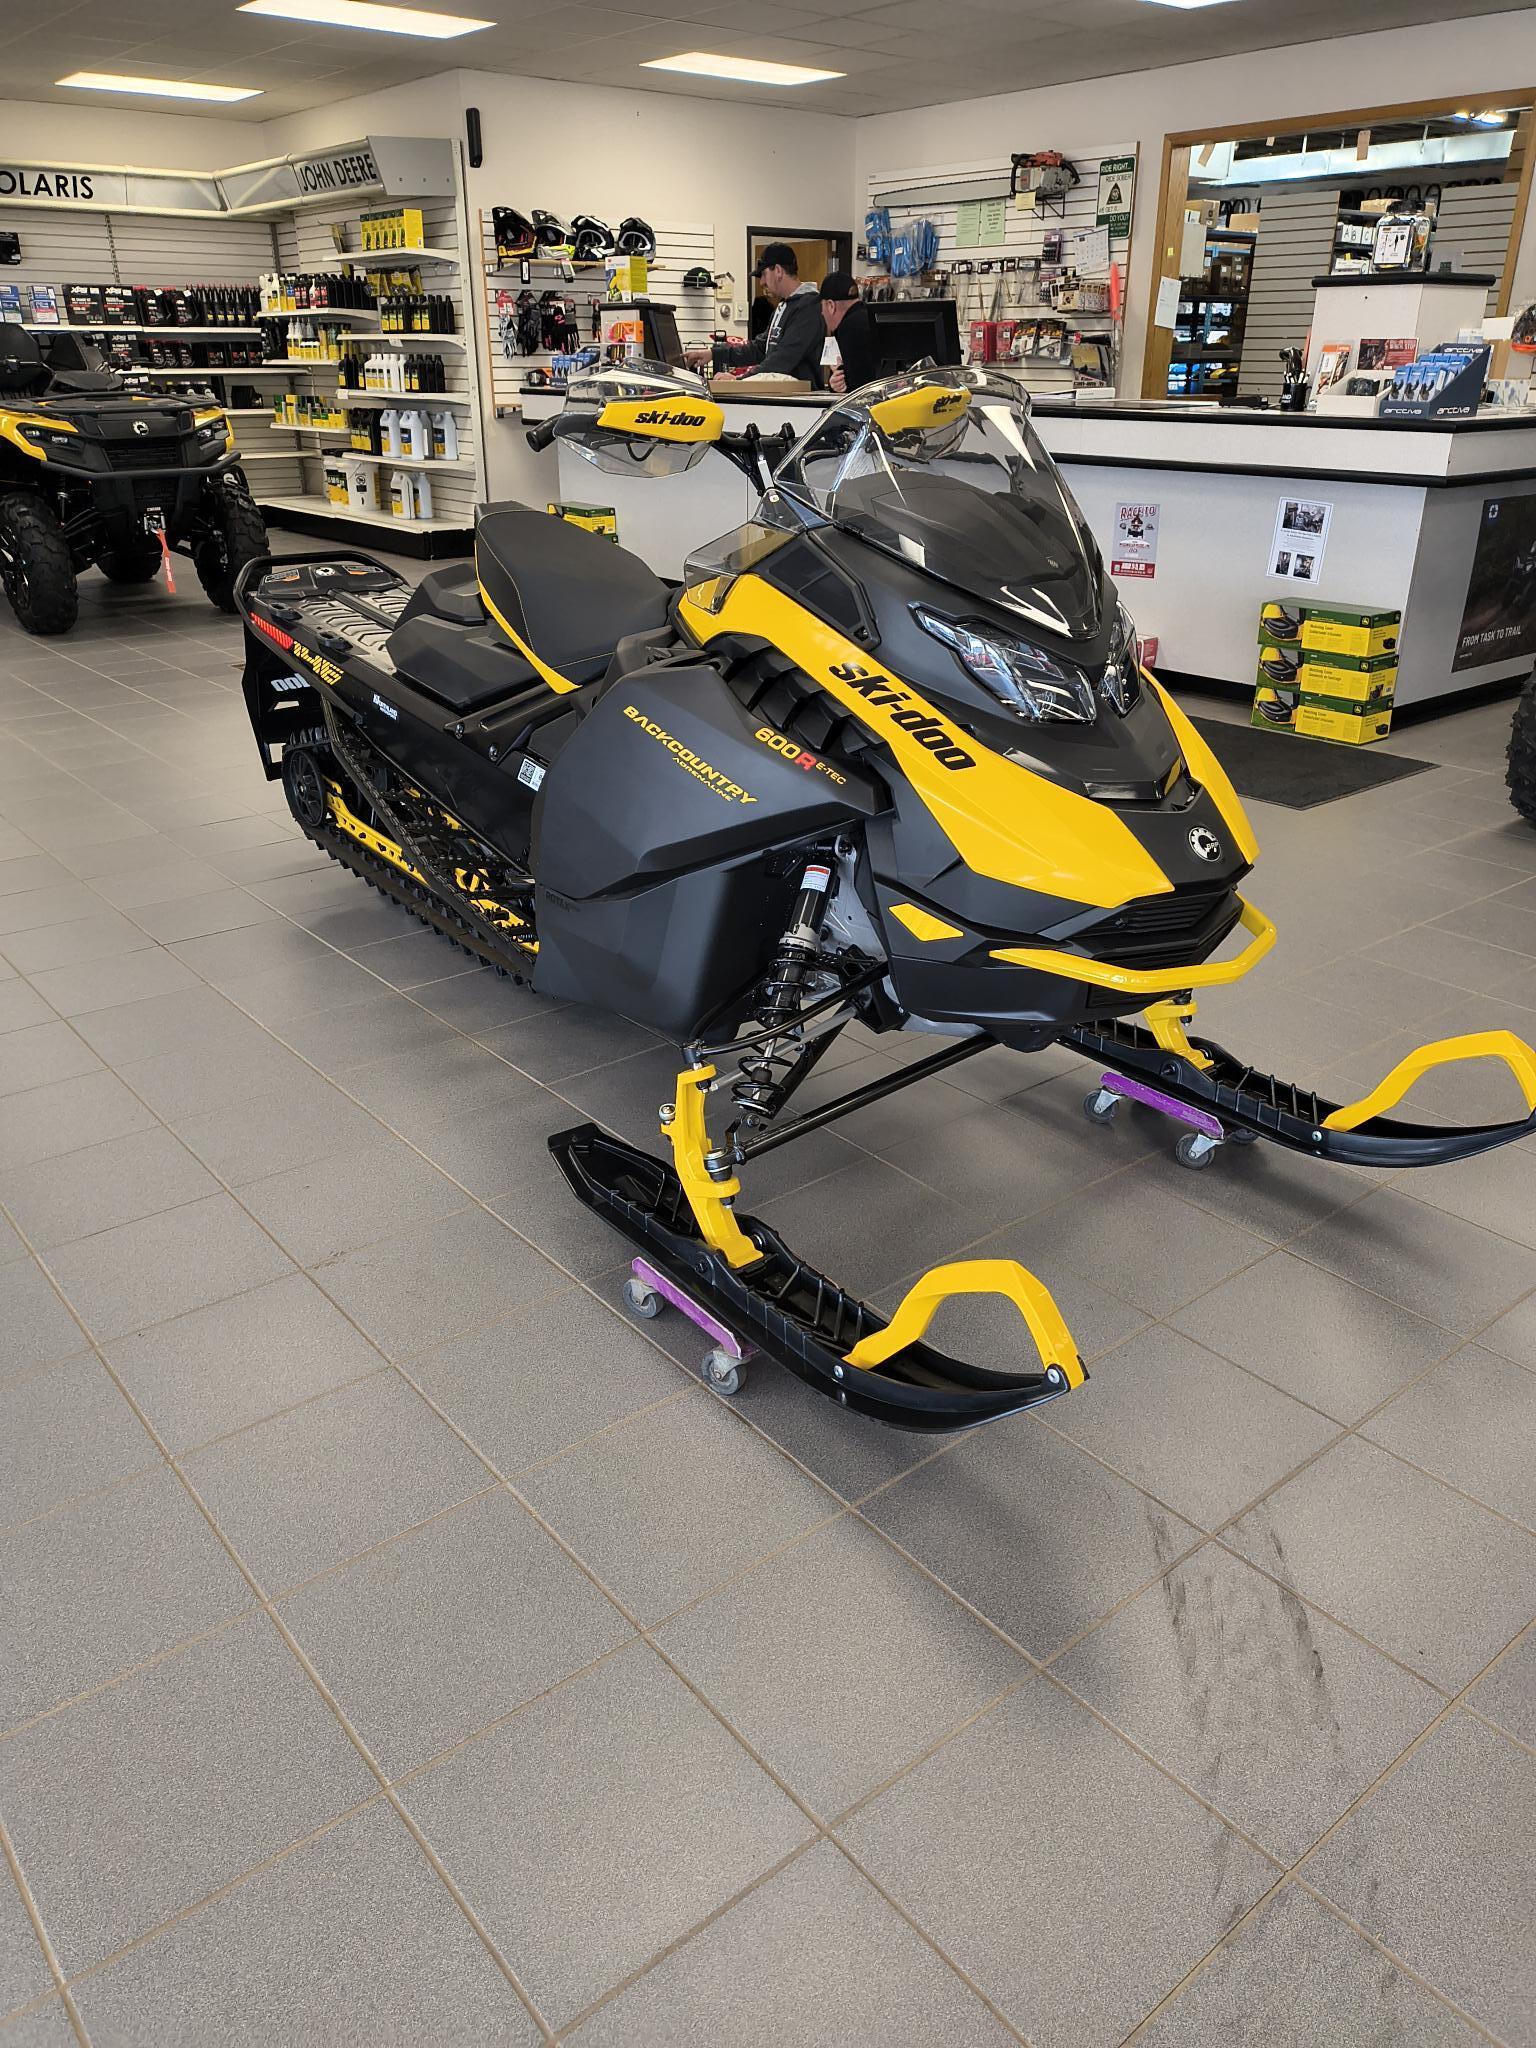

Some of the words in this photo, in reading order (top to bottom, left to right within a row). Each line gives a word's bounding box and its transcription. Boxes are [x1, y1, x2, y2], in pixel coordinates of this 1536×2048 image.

[300, 162, 336, 191] JOHN
[333, 154, 377, 185] DEERE
[1101, 165, 1112, 174] RIDE
[1105, 175, 1115, 183] RIDE
[1109, 214, 1117, 222] DO
[634, 410, 706, 426] ski-doo
[1436, 406, 1470, 415] arctiva
[1120, 505, 1143, 520] RACE
[1144, 505, 1157, 517] TO
[1461, 633, 1479, 648] FROM
[1480, 630, 1495, 644] TASK
[1496, 628, 1504, 640] TO
[1505, 625, 1522, 638] TRAIL
[828, 662, 977, 771] ski-doo
[623, 705, 758, 805] BACKCOUNTRY
[672, 757, 733, 802] ADRENALINE
[815, 762, 847, 785] E-TEC
[545, 891, 571, 913] ROTAX
